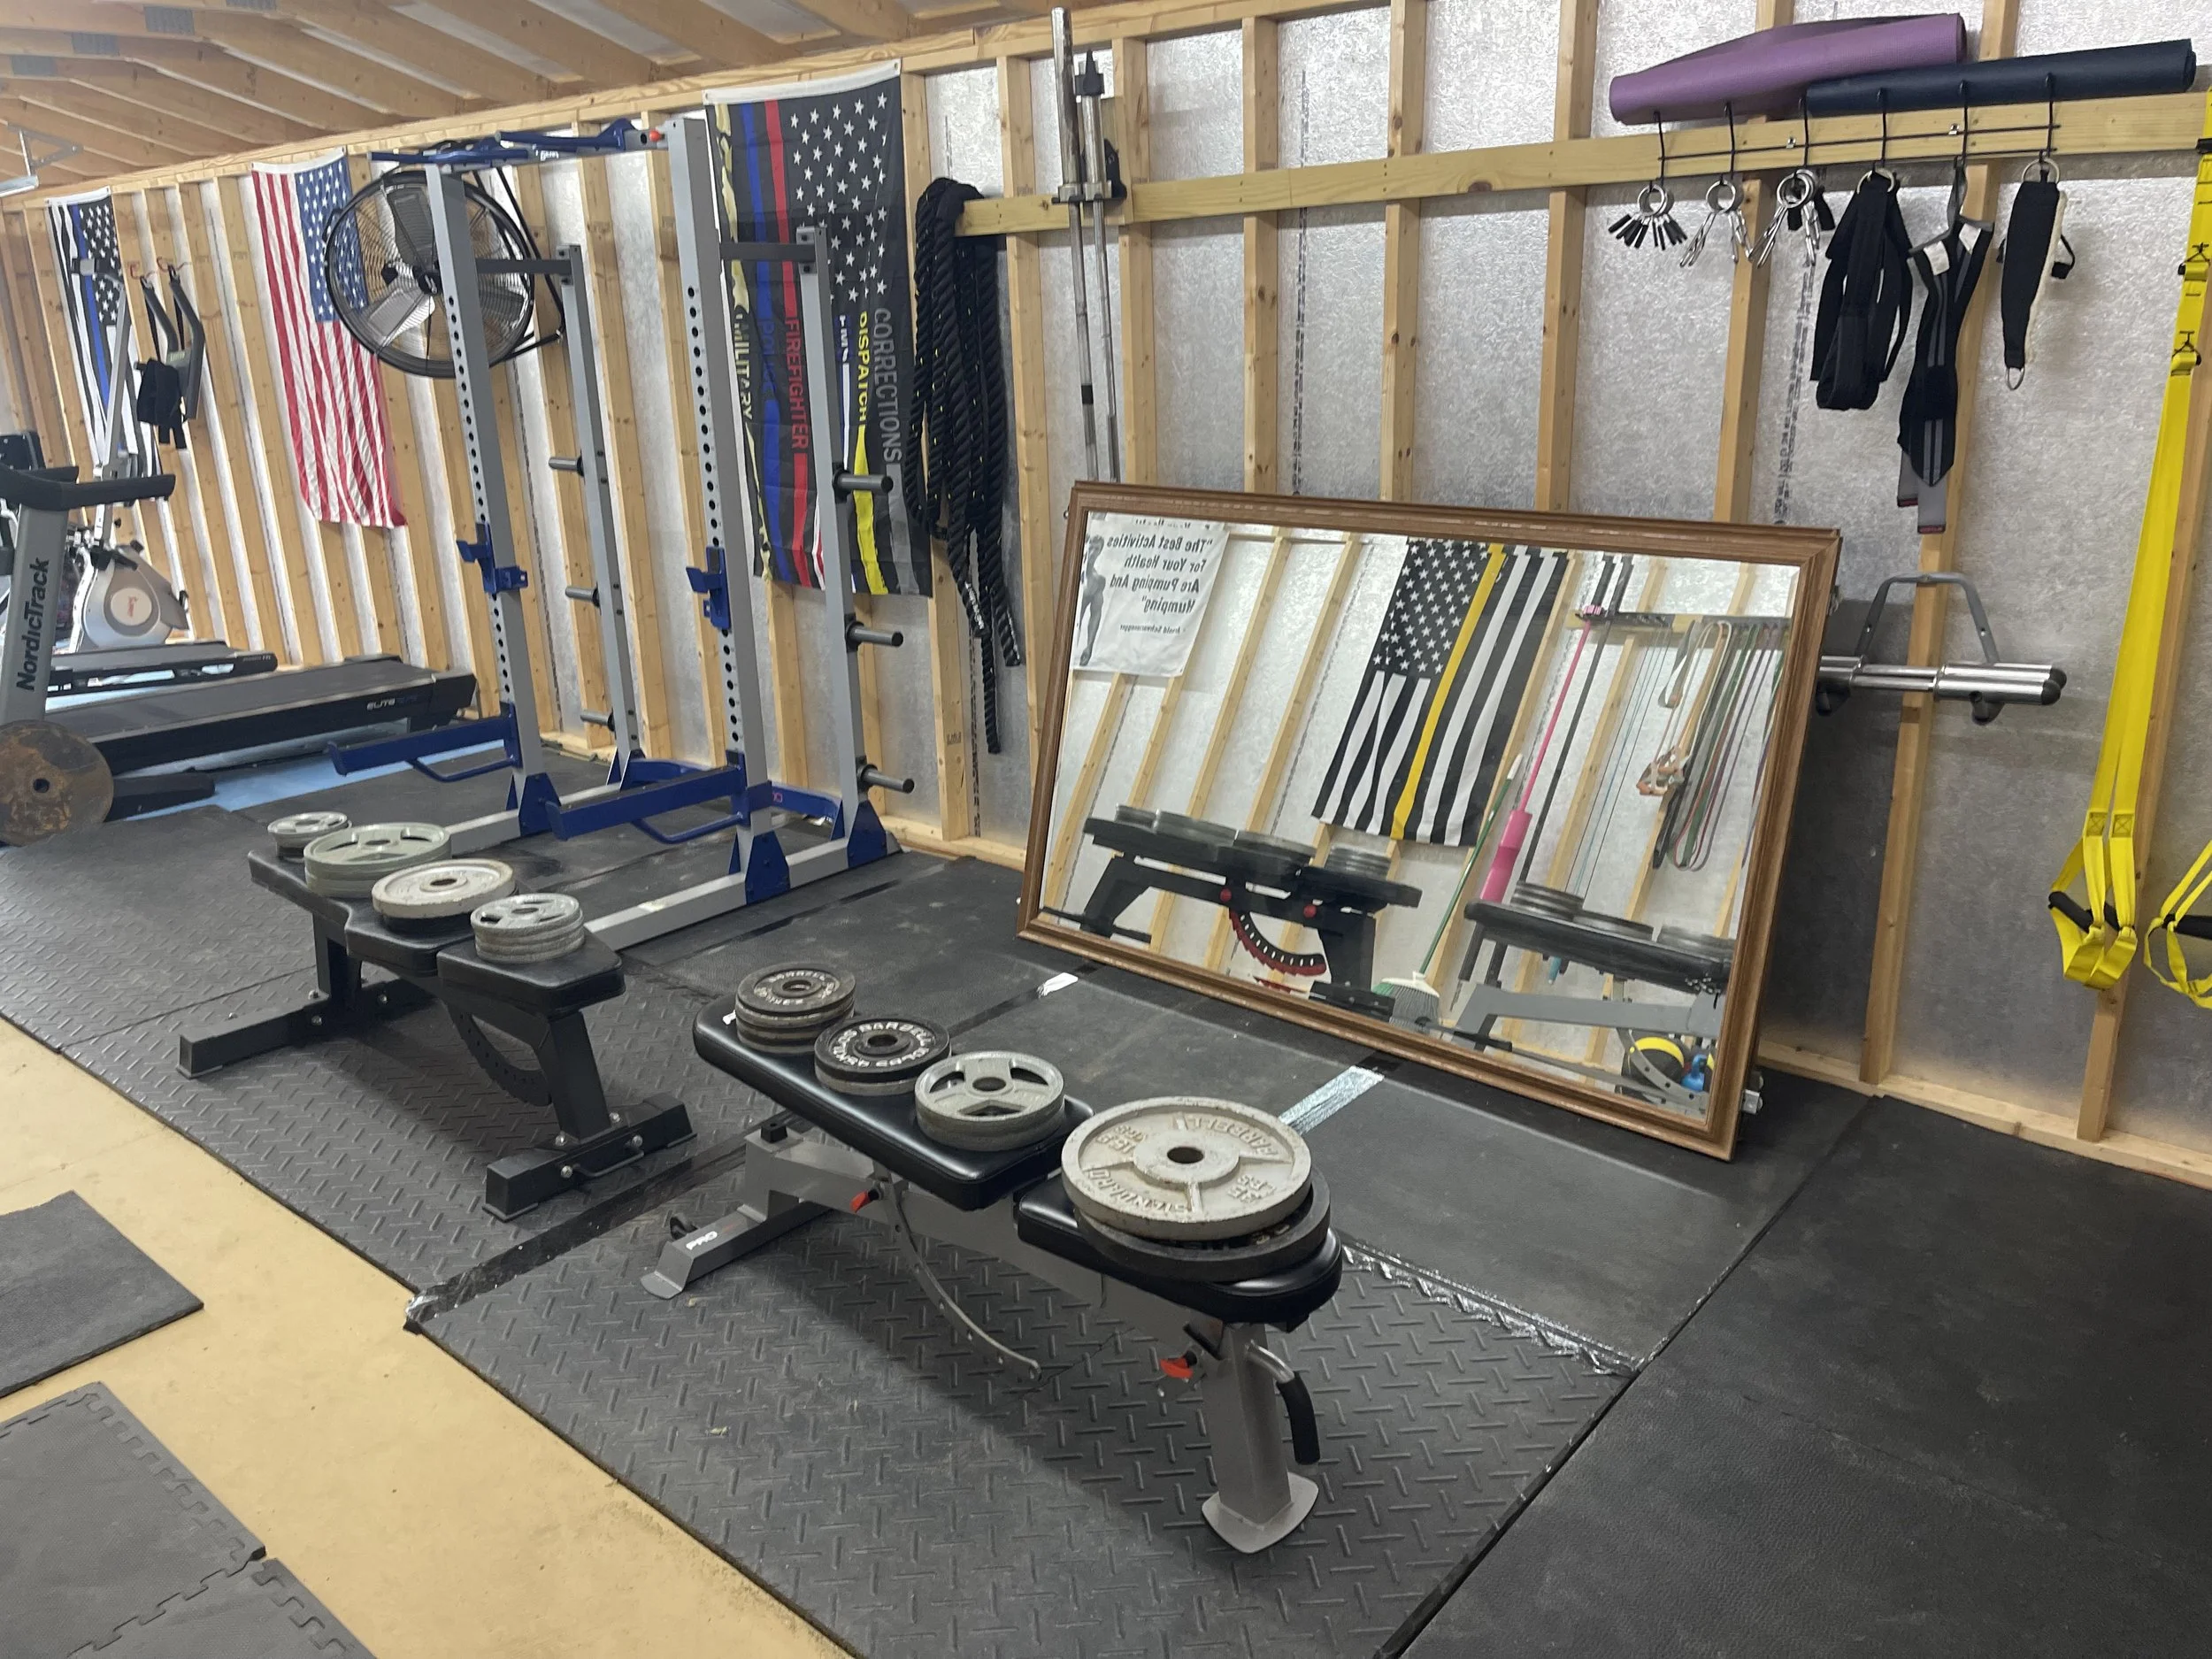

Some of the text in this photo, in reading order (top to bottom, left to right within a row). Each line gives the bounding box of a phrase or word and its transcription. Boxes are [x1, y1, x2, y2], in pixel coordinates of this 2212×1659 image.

[785, 319, 809, 449] FIREFIGHTER
[857, 311, 871, 422] DISPATCH
[873, 308, 902, 462] CORRECTIONS
[16, 558, 49, 691] NordicTrack
[1087, 1167, 1187, 1214] STANDARD
[1185, 1114, 1279, 1156] BARBELL
[685, 1230, 718, 1250] PRO
